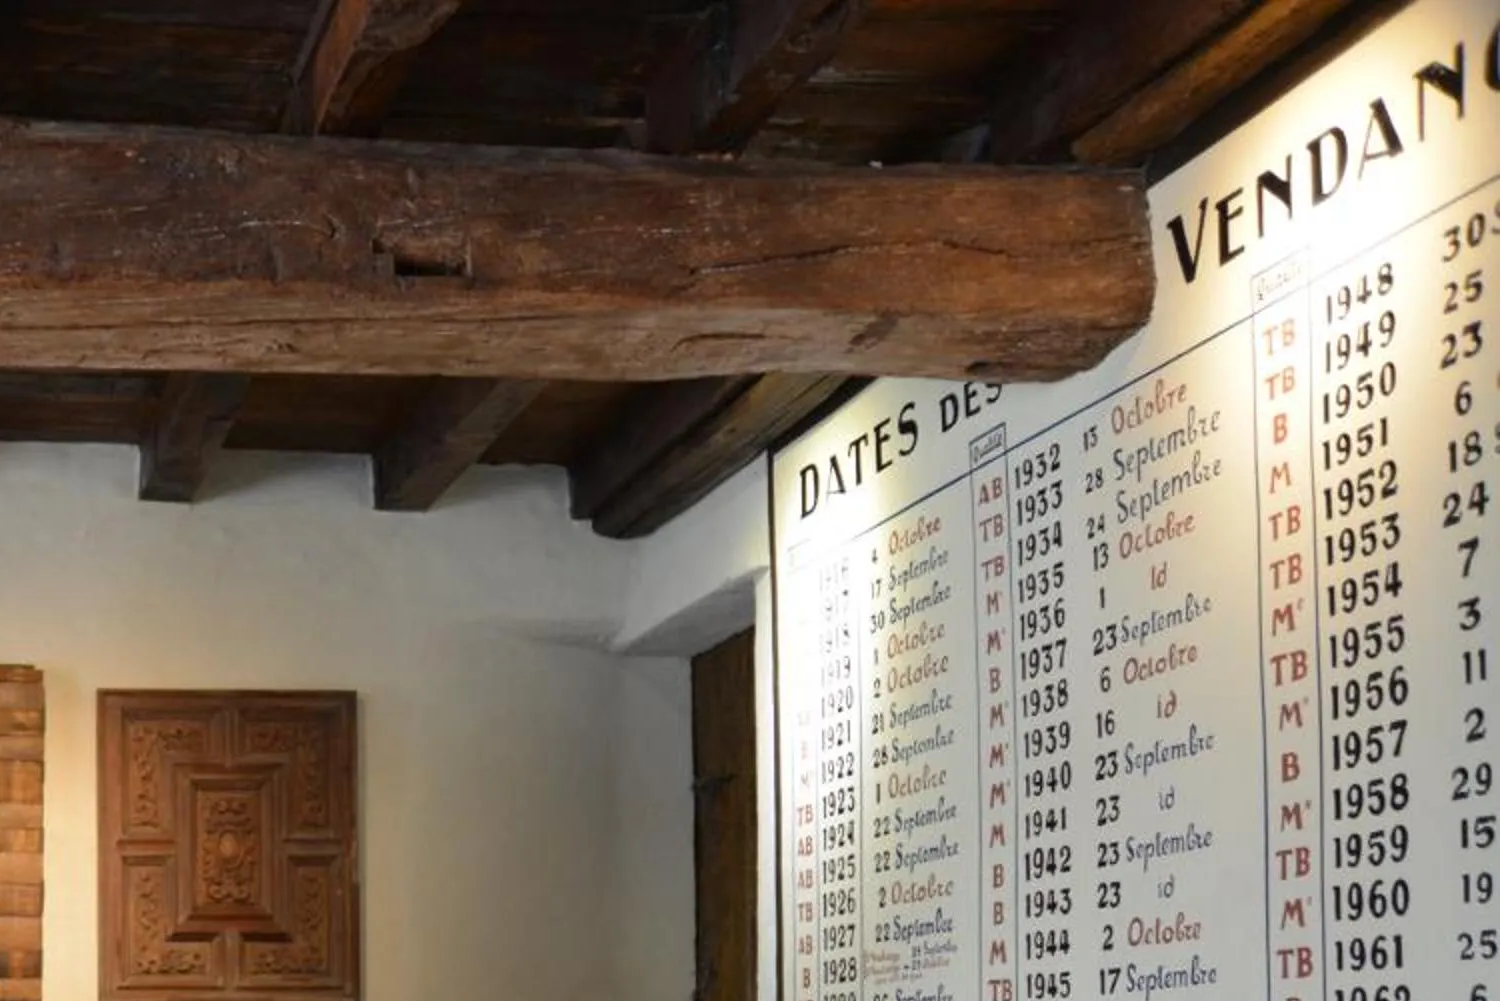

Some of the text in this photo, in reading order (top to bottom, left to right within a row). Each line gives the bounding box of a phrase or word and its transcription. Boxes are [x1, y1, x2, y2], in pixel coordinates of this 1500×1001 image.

[1263, 318, 1295, 356] TB
[1326, 262, 1394, 325] 1948
[1442, 212, 1485, 262] 30
[1264, 269, 1483, 400] TB 1949 25
[1273, 320, 1483, 445] B 1950 23
[978, 476, 1002, 506] AB
[1015, 443, 1061, 488] 1932
[1111, 378, 1187, 434] Octobre
[1322, 416, 1388, 471] 1951
[1454, 380, 1472, 417] 6
[798, 402, 919, 520] DATES
[979, 406, 1221, 542] TB 1933 28 Septembre
[1268, 504, 1301, 542] TB
[1324, 459, 1398, 520] 1952
[1448, 430, 1483, 473] 18
[981, 450, 1222, 581] TB 1934 24 Septembre
[1269, 481, 1489, 590] TB 1953 24
[1018, 511, 1196, 604] 1935 13 Octobre
[1327, 536, 1480, 616] 1954 7
[870, 610, 885, 634] 30
[889, 581, 952, 630] Septembre
[871, 578, 881, 599] 17
[1020, 598, 1065, 641] 1936
[1099, 586, 1106, 609] 1
[887, 620, 945, 659] Octobre
[988, 592, 1212, 694] B 1937 23 Septembre
[1270, 596, 1481, 687] TB 1955 3
[887, 654, 949, 692] Octobre
[1022, 643, 1198, 718] 1938 6 Octobre
[1331, 648, 1488, 720] 1956 11
[821, 719, 851, 751] 1921
[1024, 721, 1071, 758] 1939
[1096, 710, 1115, 738] 16
[1025, 723, 1216, 798] 1940 23 Septembre
[1281, 707, 1487, 783] B 1957 2
[821, 751, 854, 784] 1922
[823, 786, 855, 819] 1923
[876, 783, 881, 805] 1
[888, 763, 947, 798] Octobre
[1333, 762, 1492, 820] 1958 29
[823, 819, 855, 852] 1924
[873, 815, 890, 838] 22
[894, 796, 957, 839] Septembre
[1025, 807, 1067, 840] 1941
[1096, 795, 1120, 826] 23
[1158, 786, 1176, 811] id
[823, 853, 856, 884] 1925
[874, 850, 890, 873] 22
[992, 822, 1213, 889] B 1942 23 Septembre
[1275, 815, 1497, 881] TB 1959 15
[823, 887, 856, 918] 1926
[879, 887, 887, 908] 2
[891, 873, 955, 904] Octobre
[993, 874, 1175, 926] B 1943 23 id
[1333, 871, 1493, 922] 1960 19
[823, 924, 856, 951] 1927
[989, 940, 1007, 965] M
[1026, 929, 1070, 960] 1944
[1102, 924, 1114, 951] 2
[1127, 912, 1202, 947] Octobre
[1277, 929, 1498, 980] TB 1961 25
[823, 956, 857, 985] 1928
[1027, 972, 1071, 1000] 1945
[1099, 968, 1121, 995] 17
